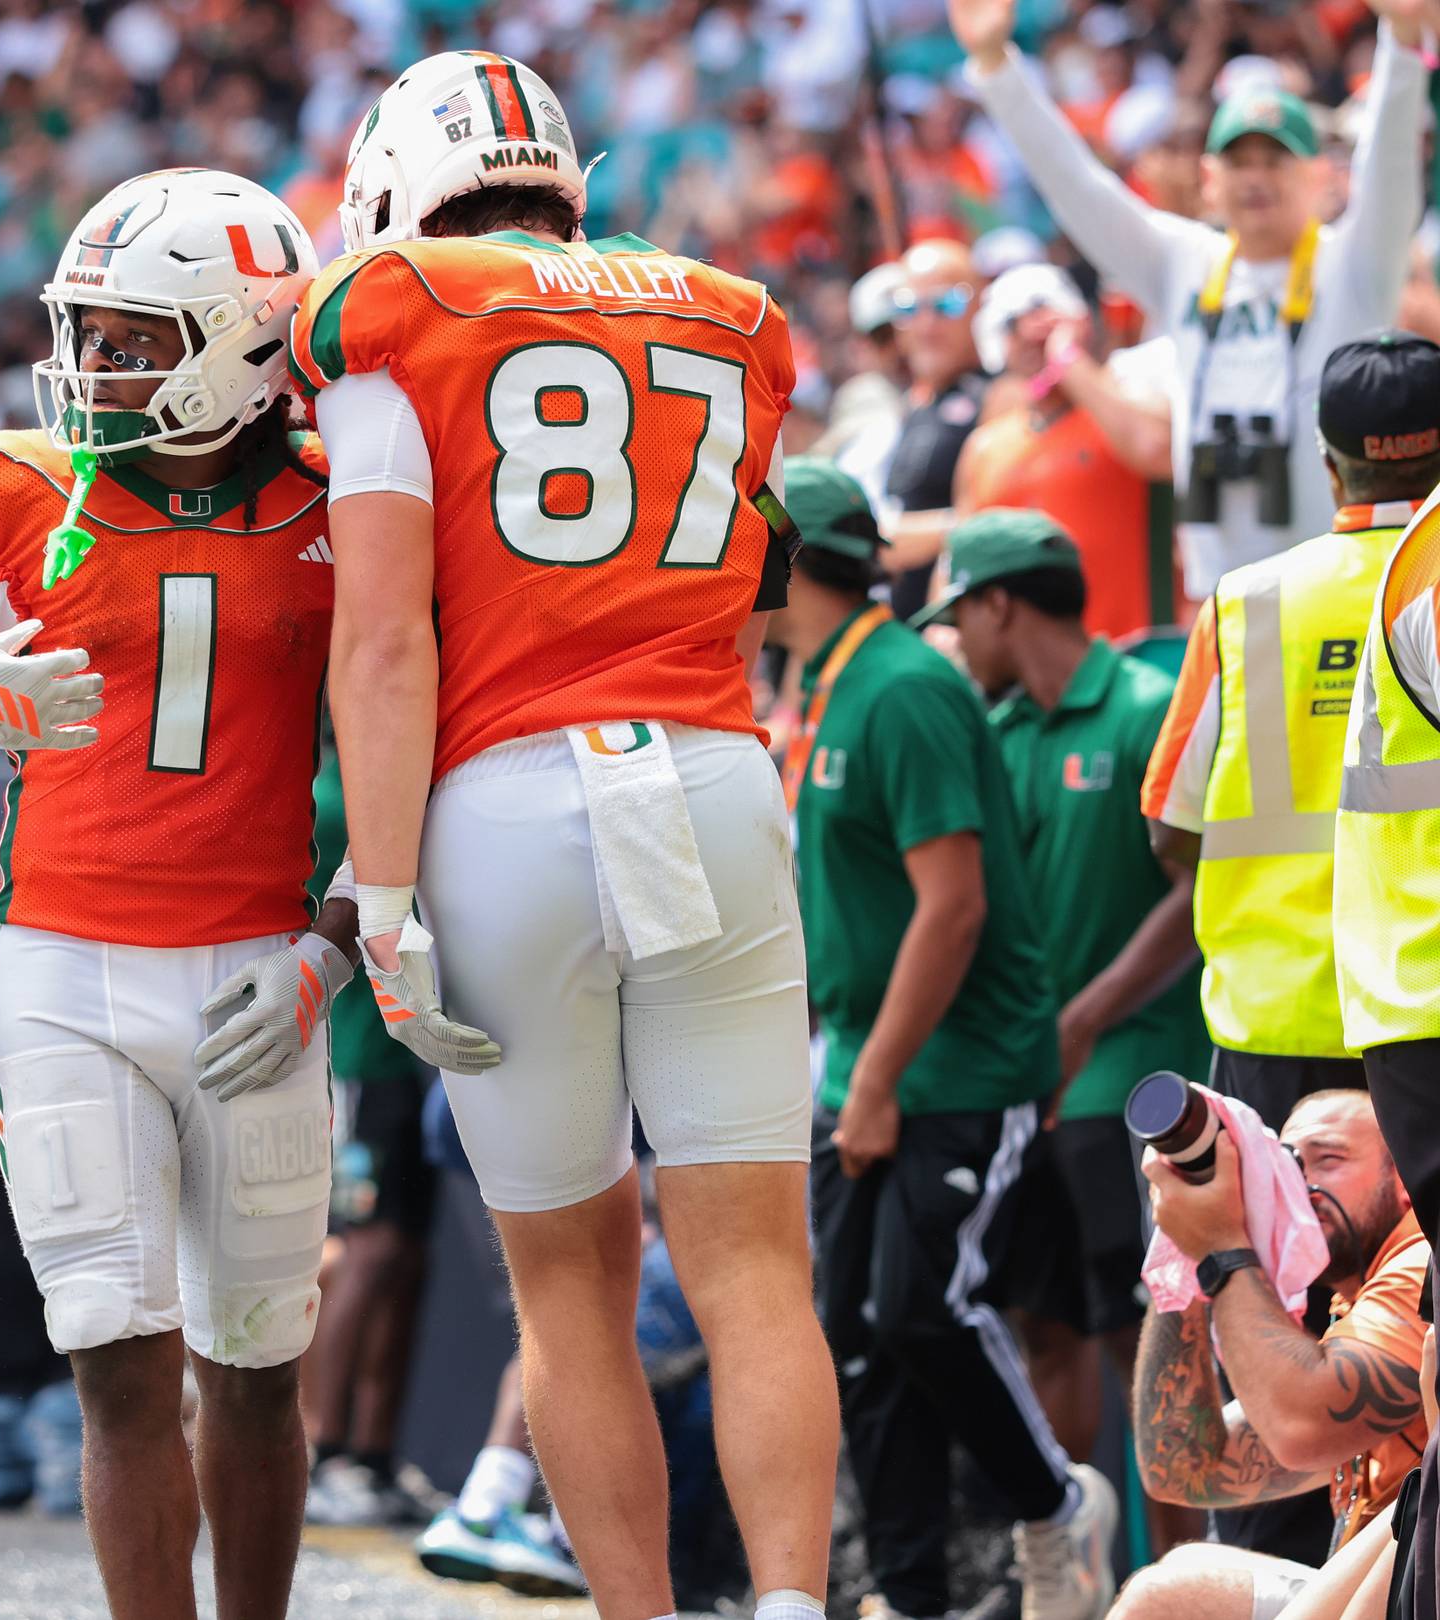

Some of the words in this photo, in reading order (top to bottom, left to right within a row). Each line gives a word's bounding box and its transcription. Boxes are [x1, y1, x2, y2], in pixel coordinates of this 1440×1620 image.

[444, 116, 472, 144] 87
[479, 147, 558, 172] MIAMI
[225, 224, 299, 279] U
[65, 270, 105, 287] MIAMI
[526, 253, 695, 303] MUELLER
[484, 340, 748, 570] 87
[168, 494, 212, 516] U
[147, 572, 218, 775] 1
[812, 746, 848, 790] U
[1062, 751, 1114, 792] U
